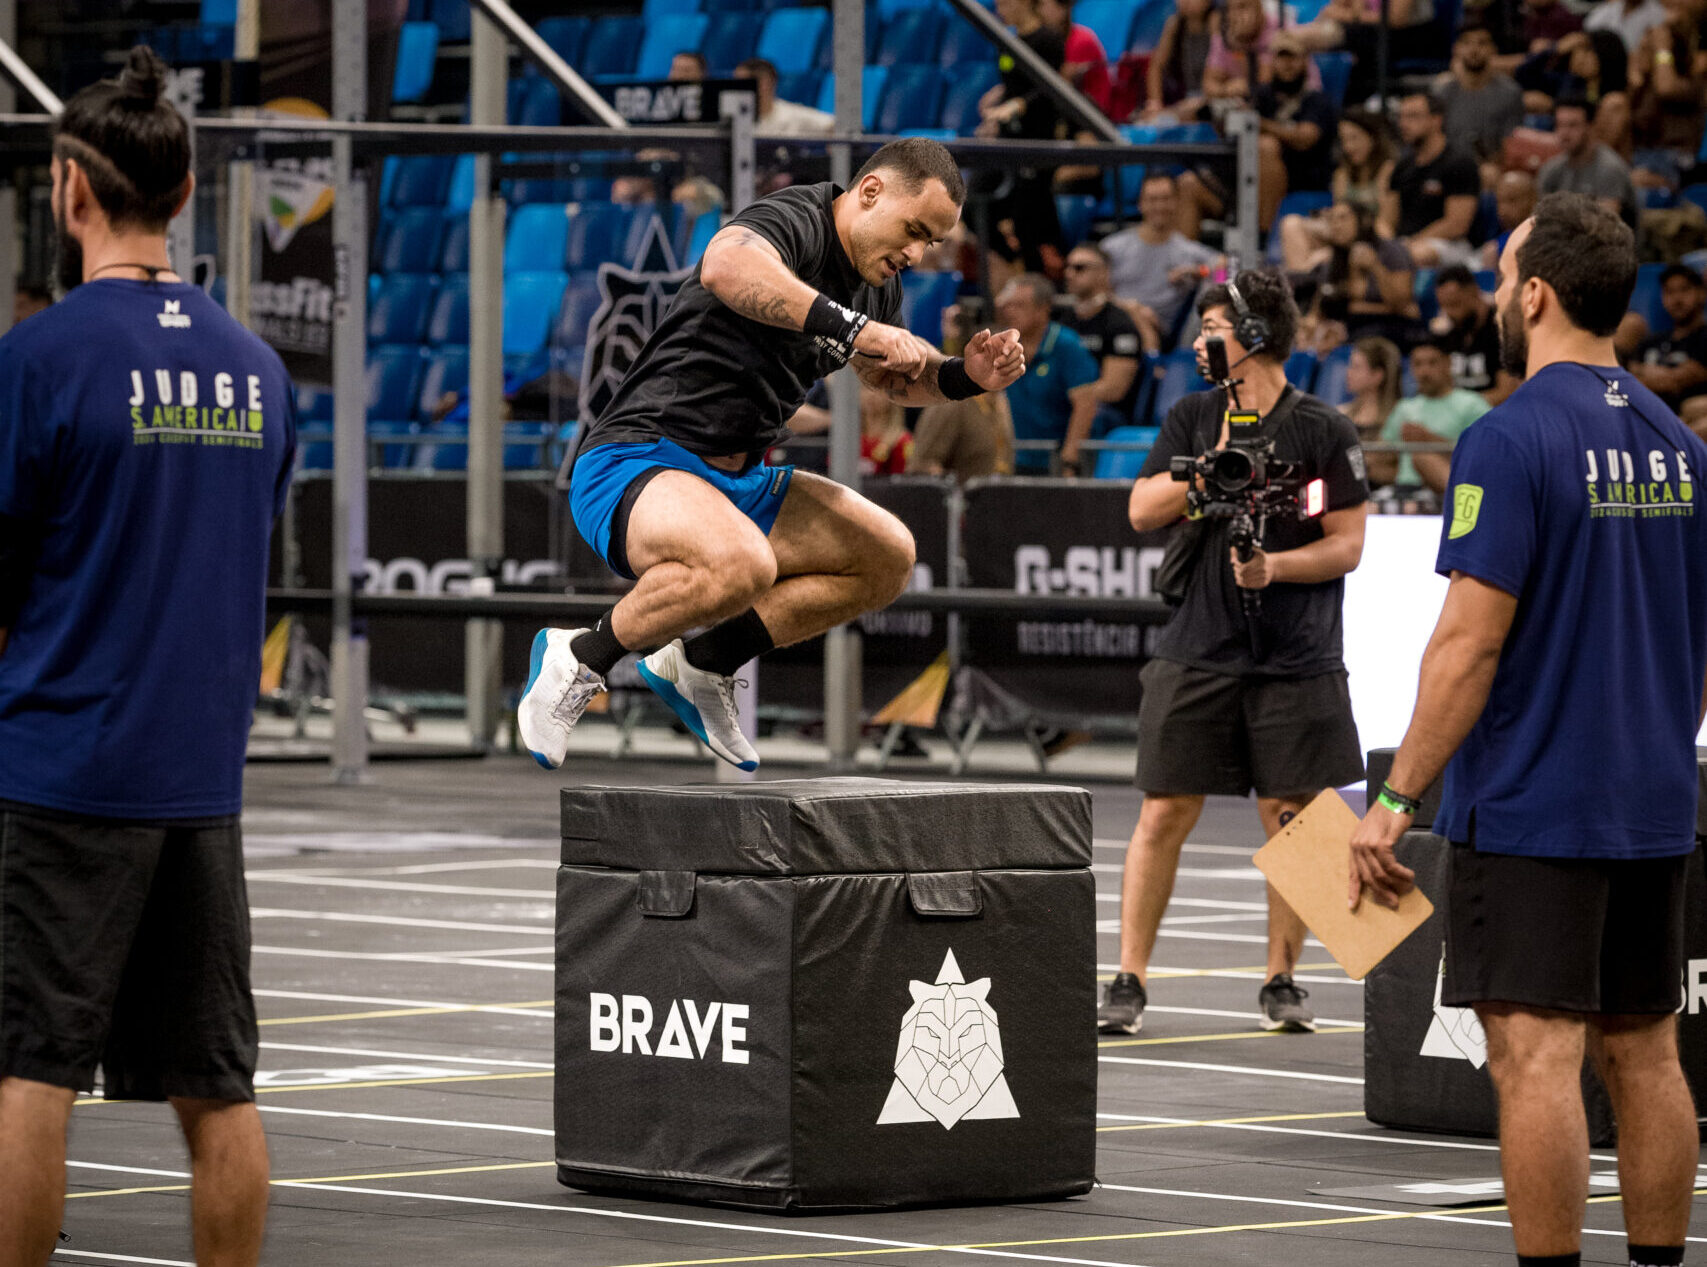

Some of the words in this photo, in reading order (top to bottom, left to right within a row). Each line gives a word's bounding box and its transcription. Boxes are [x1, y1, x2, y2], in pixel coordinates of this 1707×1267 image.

[615, 85, 702, 121] BRAVE
[129, 369, 263, 411] JUDGE
[152, 406, 238, 431] AMERICA
[590, 992, 750, 1064] BRAVE
